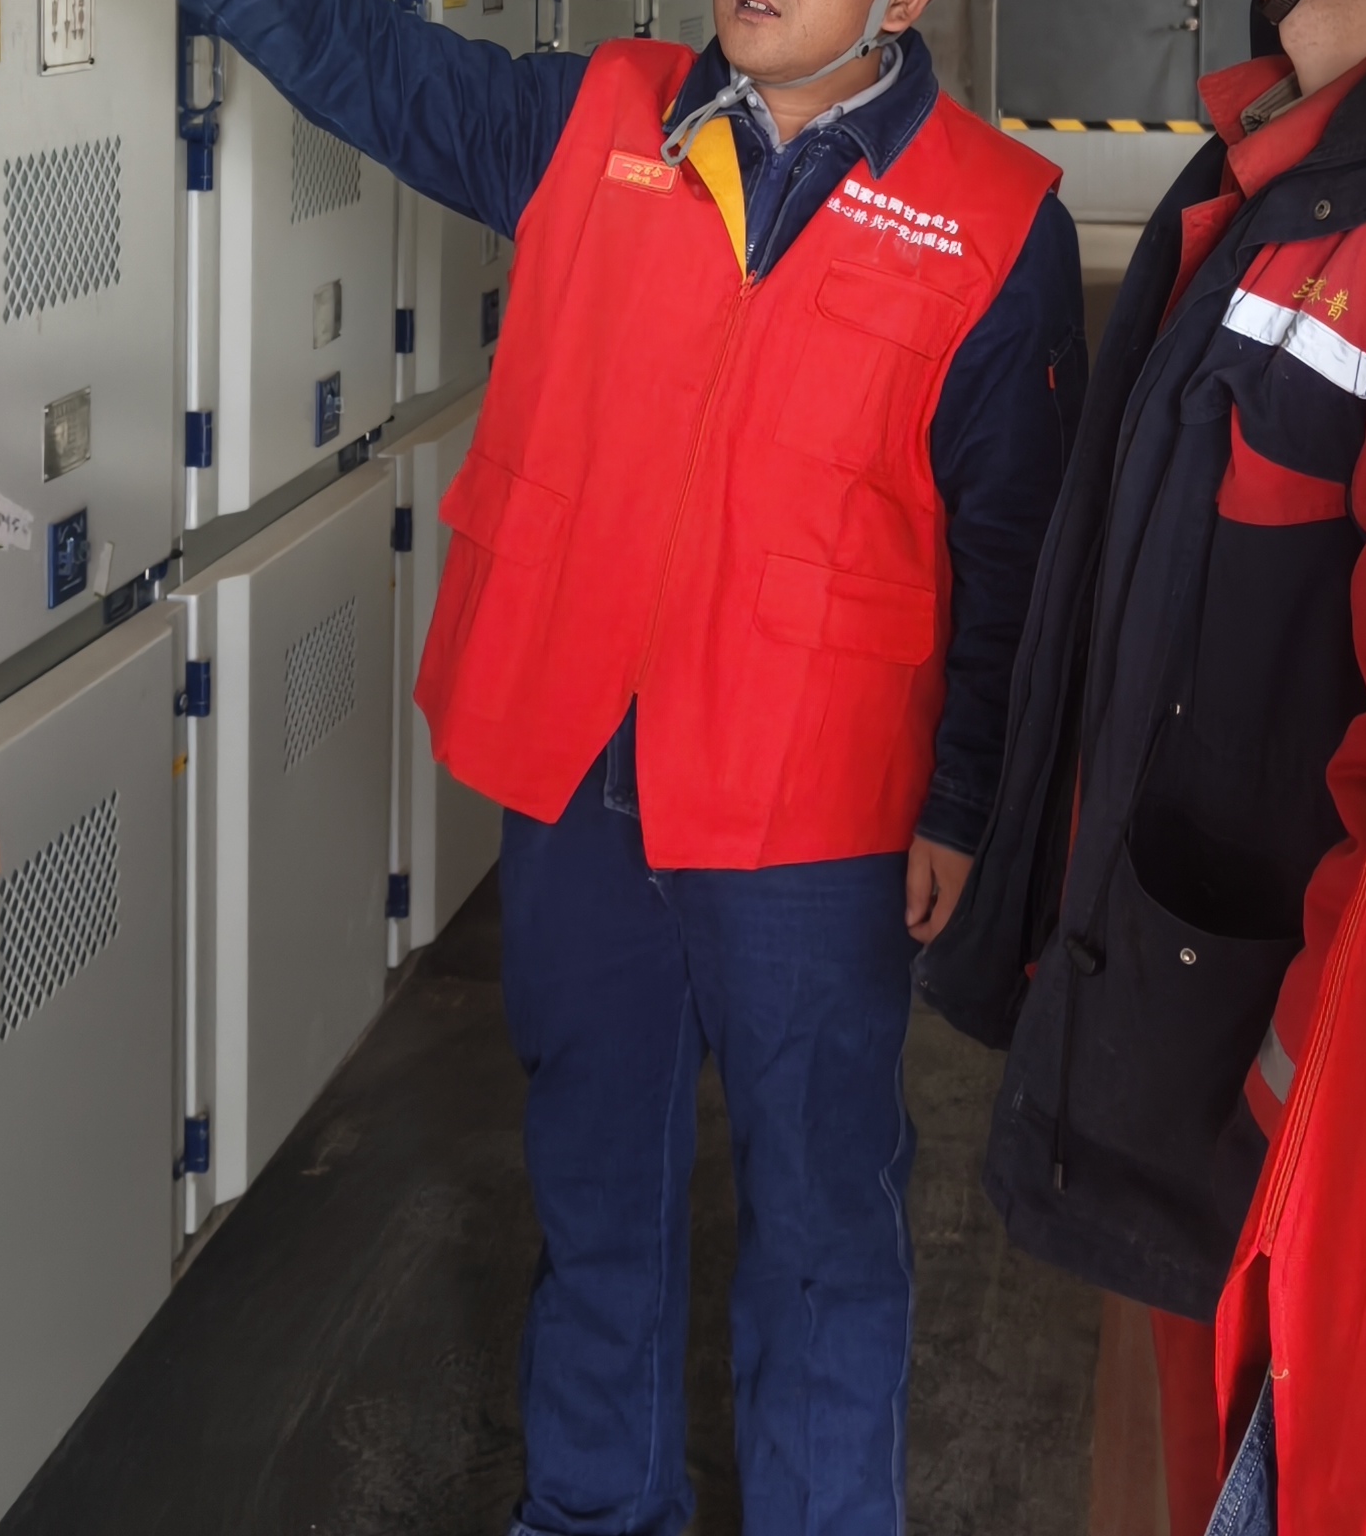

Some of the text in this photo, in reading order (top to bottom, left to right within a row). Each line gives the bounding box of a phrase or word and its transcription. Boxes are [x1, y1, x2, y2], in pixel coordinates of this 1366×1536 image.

[843, 178, 960, 235] 国家电网甘肃电力
[868, 214, 964, 257] 共产党员服务队
